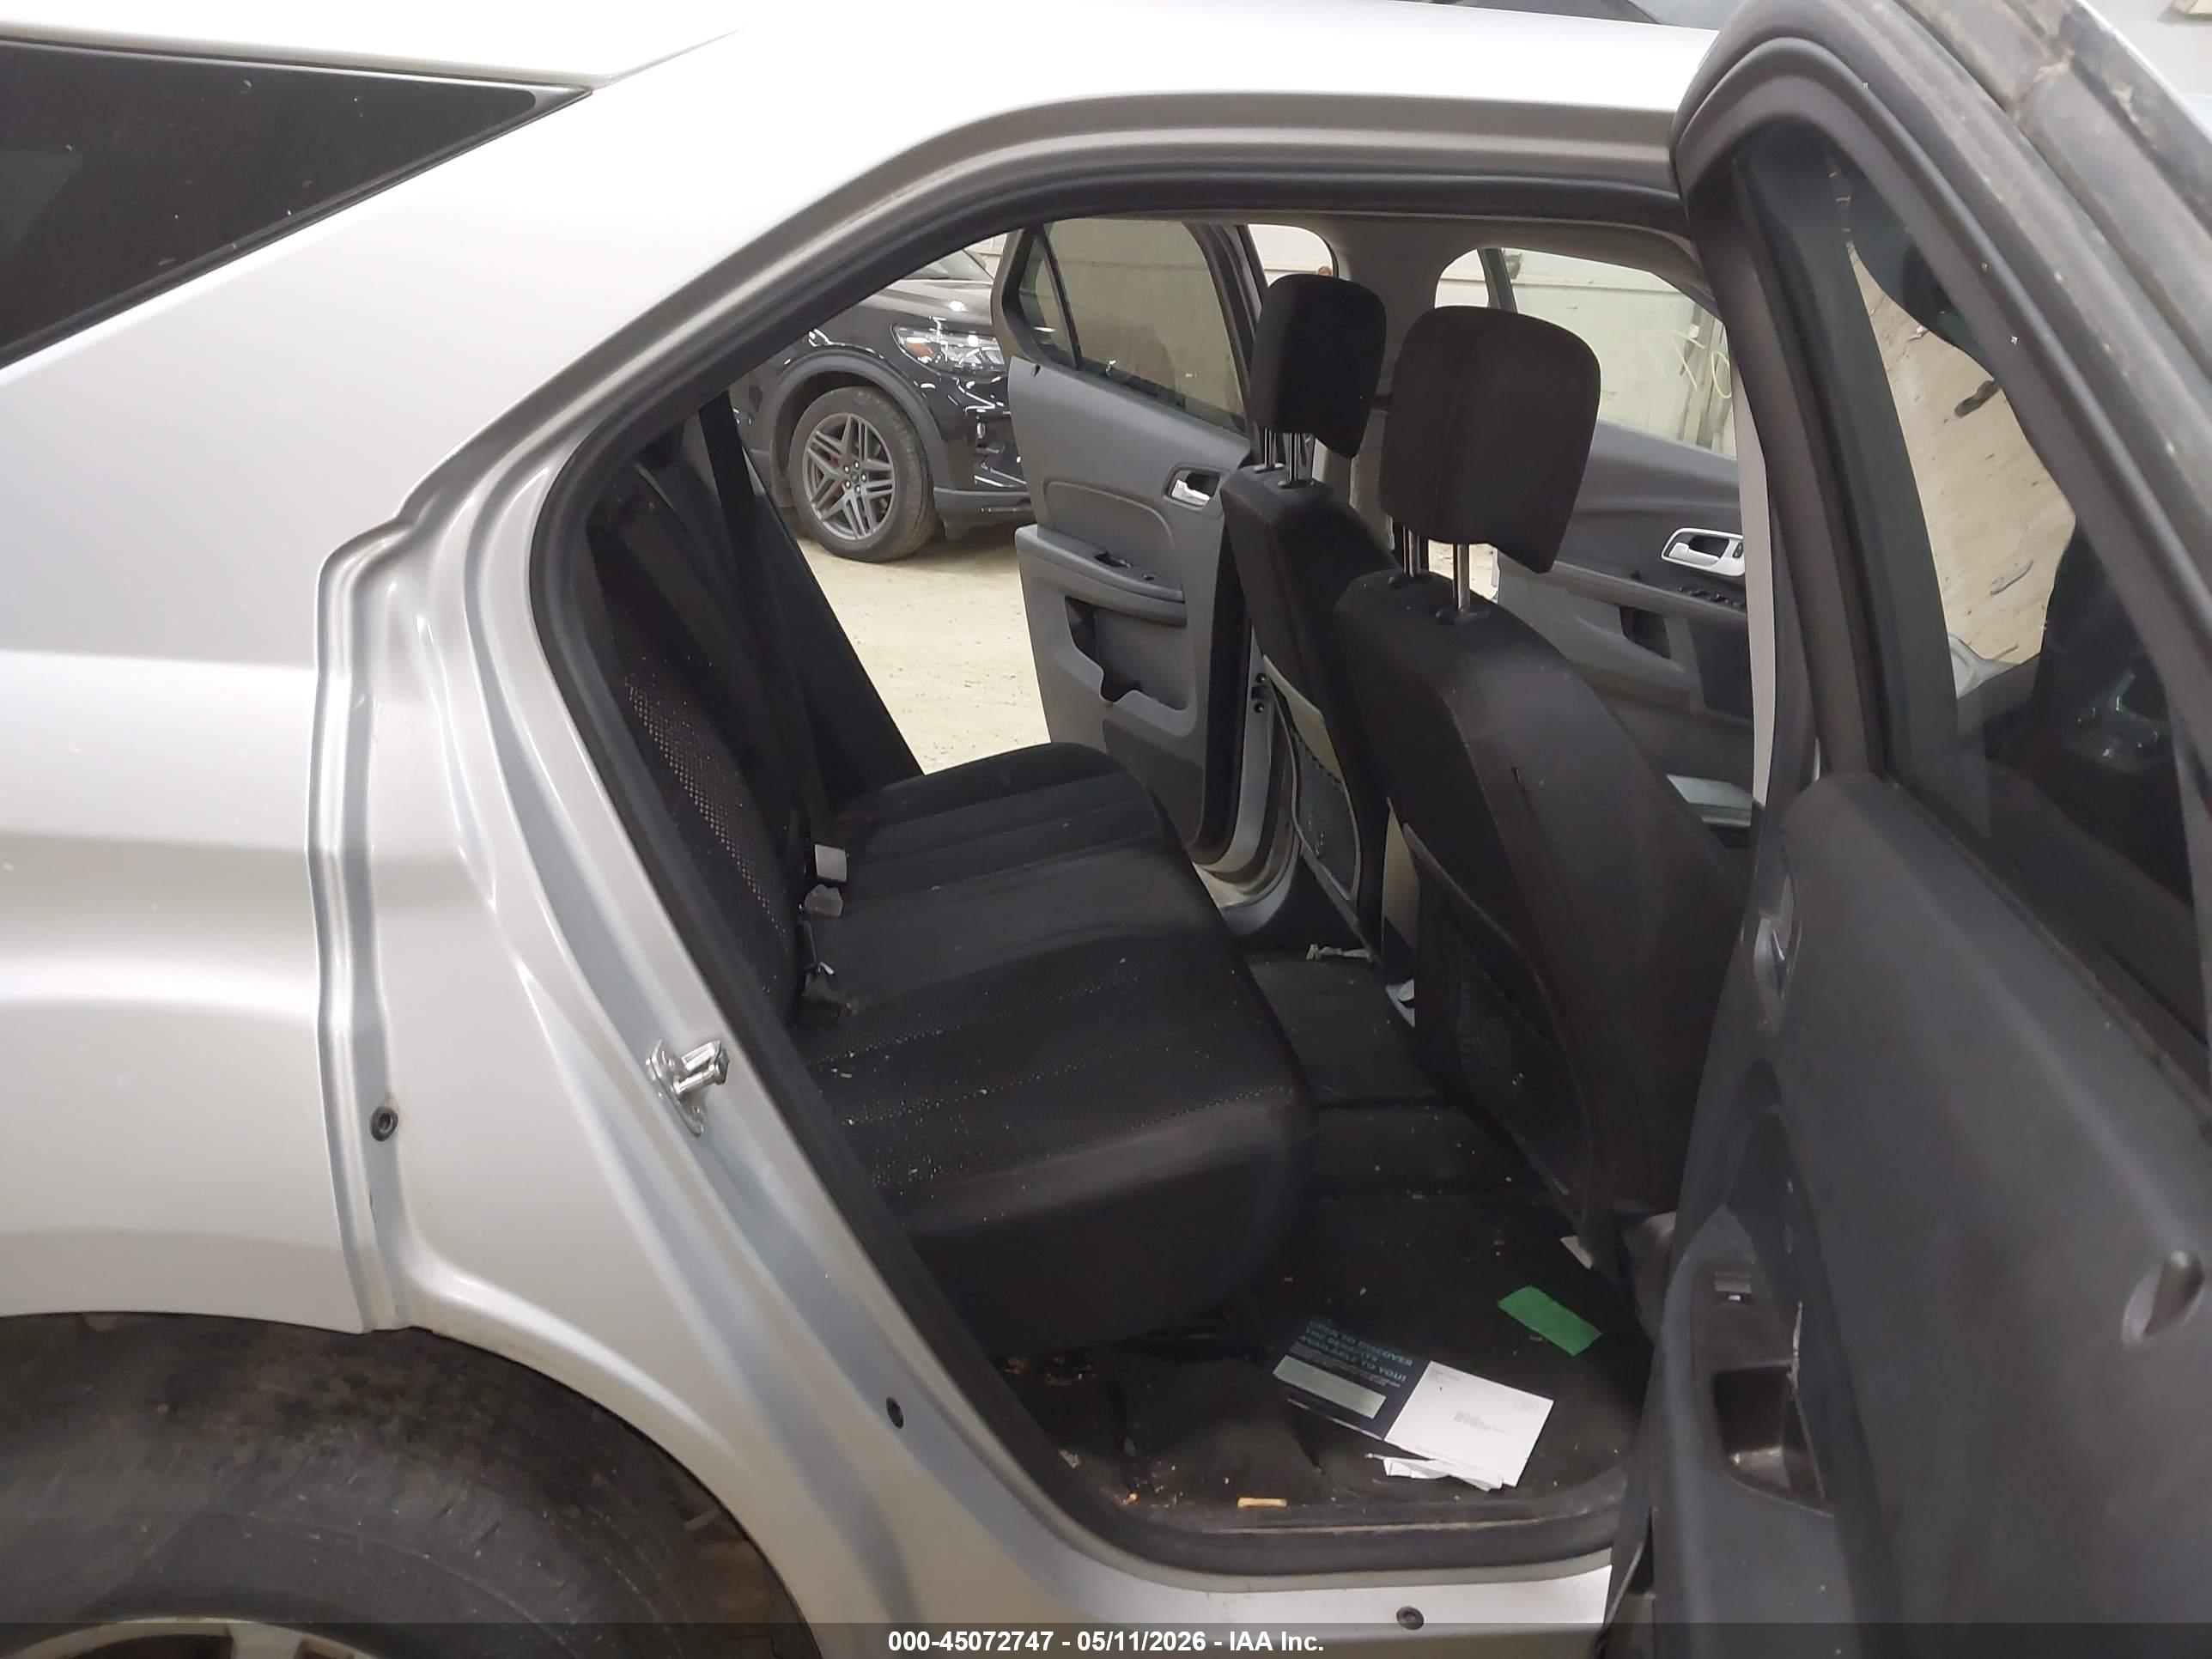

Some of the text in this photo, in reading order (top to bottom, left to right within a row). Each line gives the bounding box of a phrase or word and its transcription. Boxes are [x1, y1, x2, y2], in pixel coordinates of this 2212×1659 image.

[1358, 1340, 1413, 1367] DISCOVER
[1359, 1361, 1376, 1371] TO
[1378, 1366, 1407, 1383] YOU!
